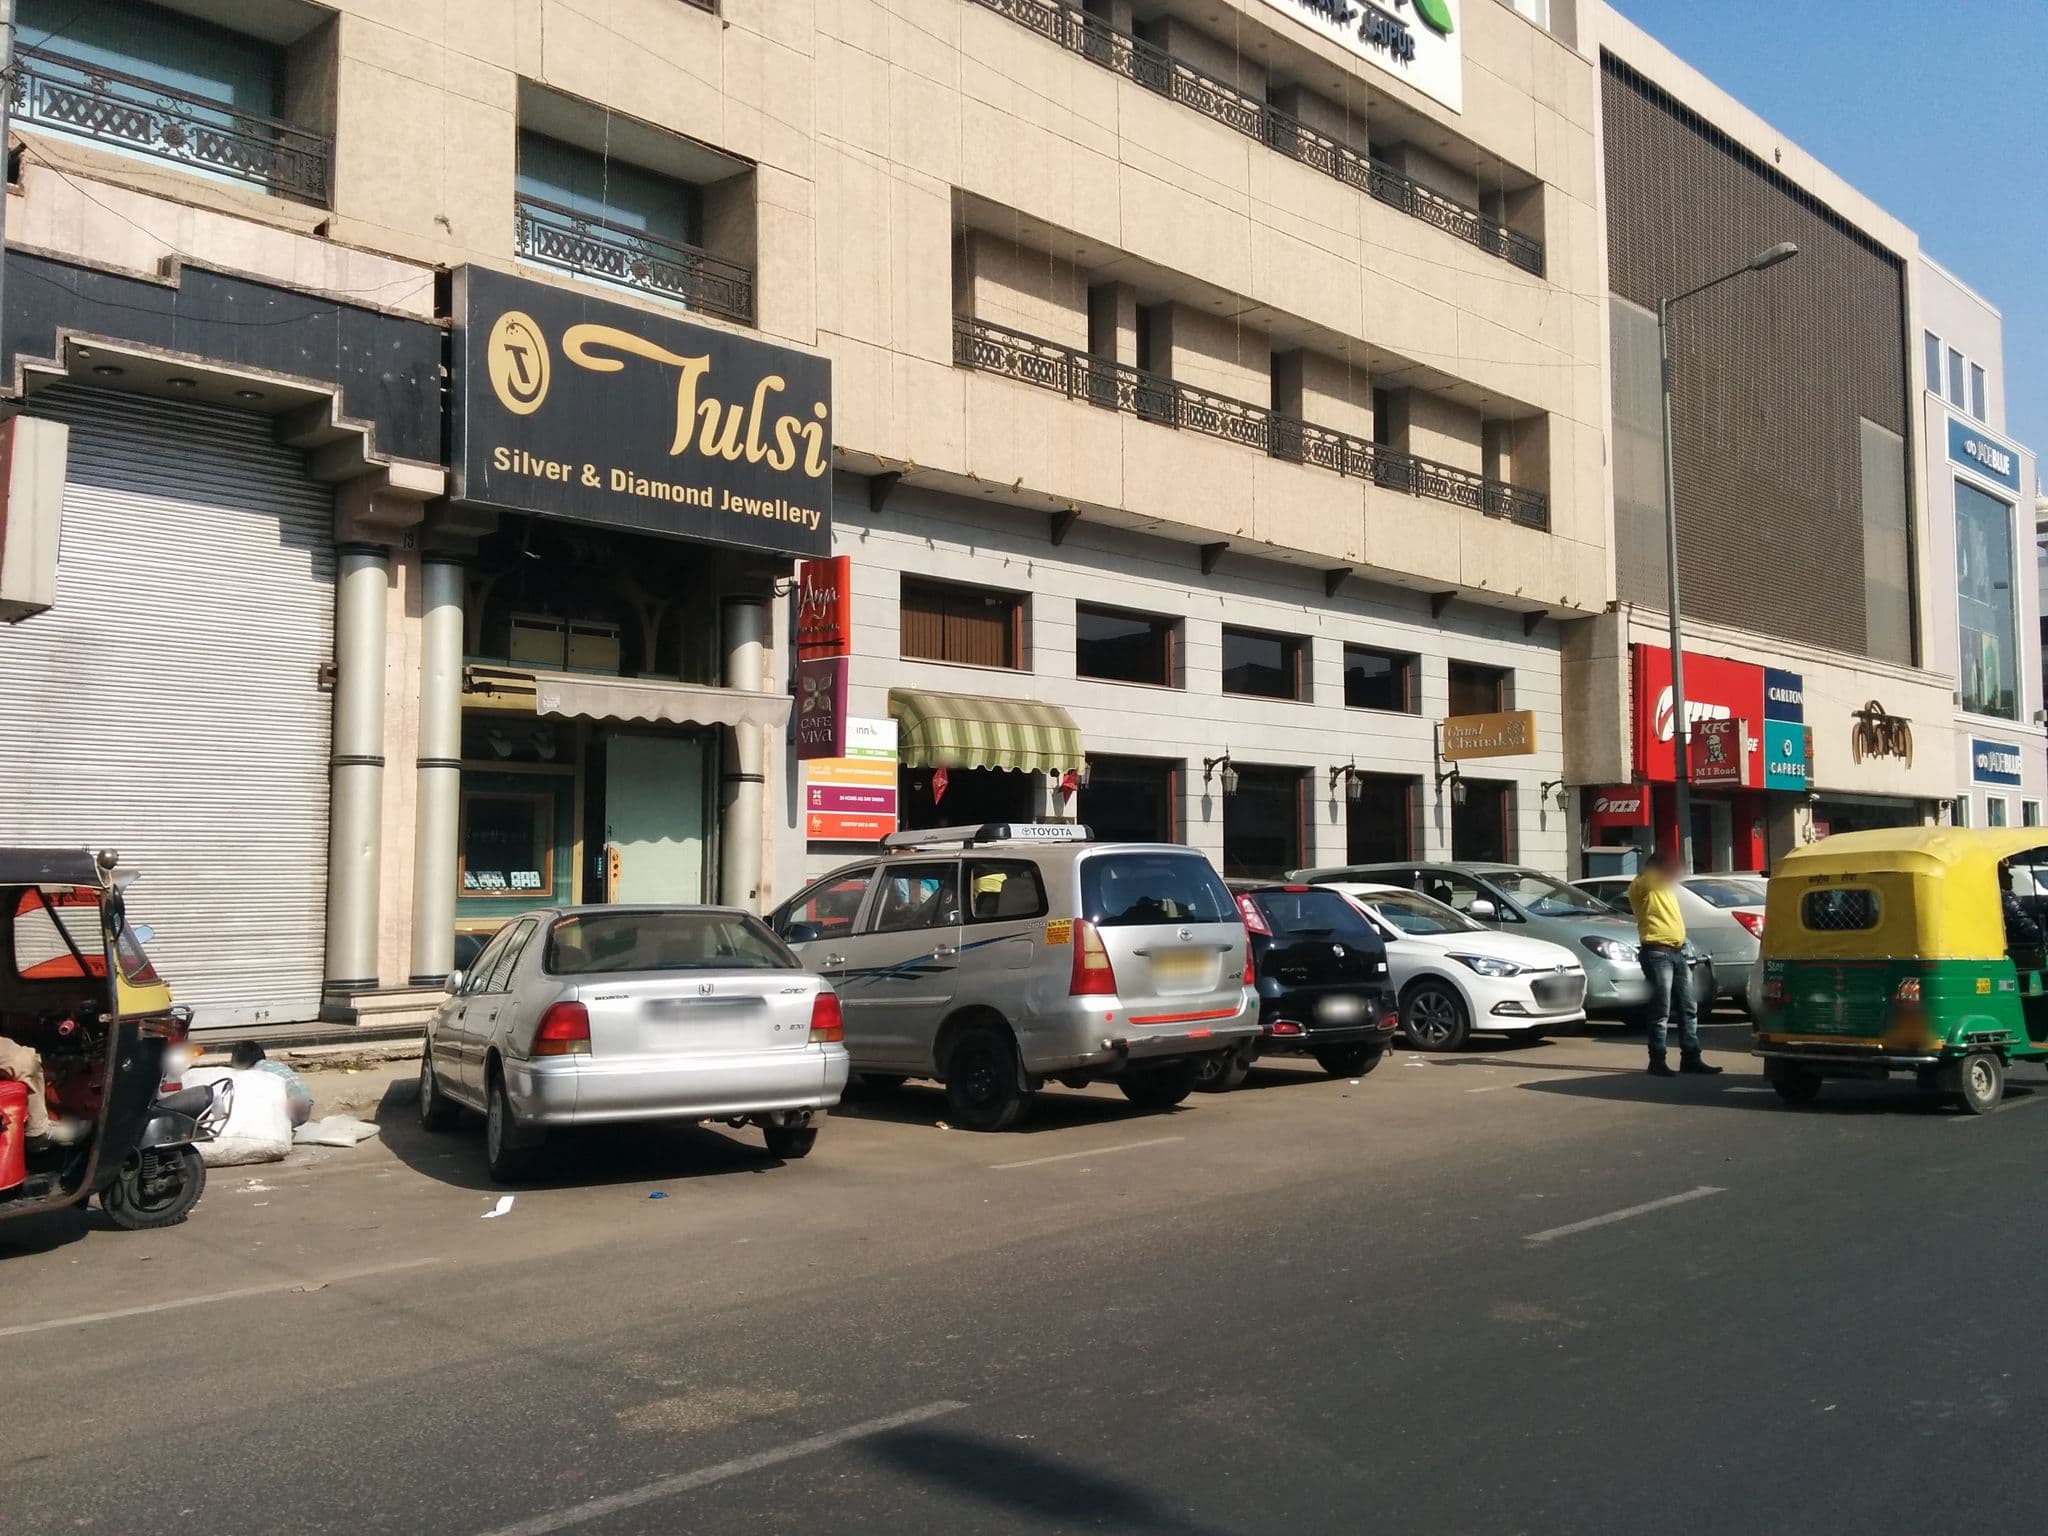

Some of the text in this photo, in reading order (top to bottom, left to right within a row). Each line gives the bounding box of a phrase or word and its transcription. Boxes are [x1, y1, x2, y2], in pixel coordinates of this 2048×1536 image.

[1364, 10, 1416, 61] JAIPUR
[562, 323, 828, 478] Tulsi
[494, 446, 821, 531] Silver & Diamond Jewellery
[1769, 687, 1804, 704] CARLTON
[800, 716, 832, 730] CAFE
[1700, 722, 1731, 735] KFC
[1695, 768, 1705, 776] M
[1714, 766, 1737, 776] Road
[1770, 762, 1805, 776] CAPRESE
[1030, 827, 1073, 836] TOYOTA
